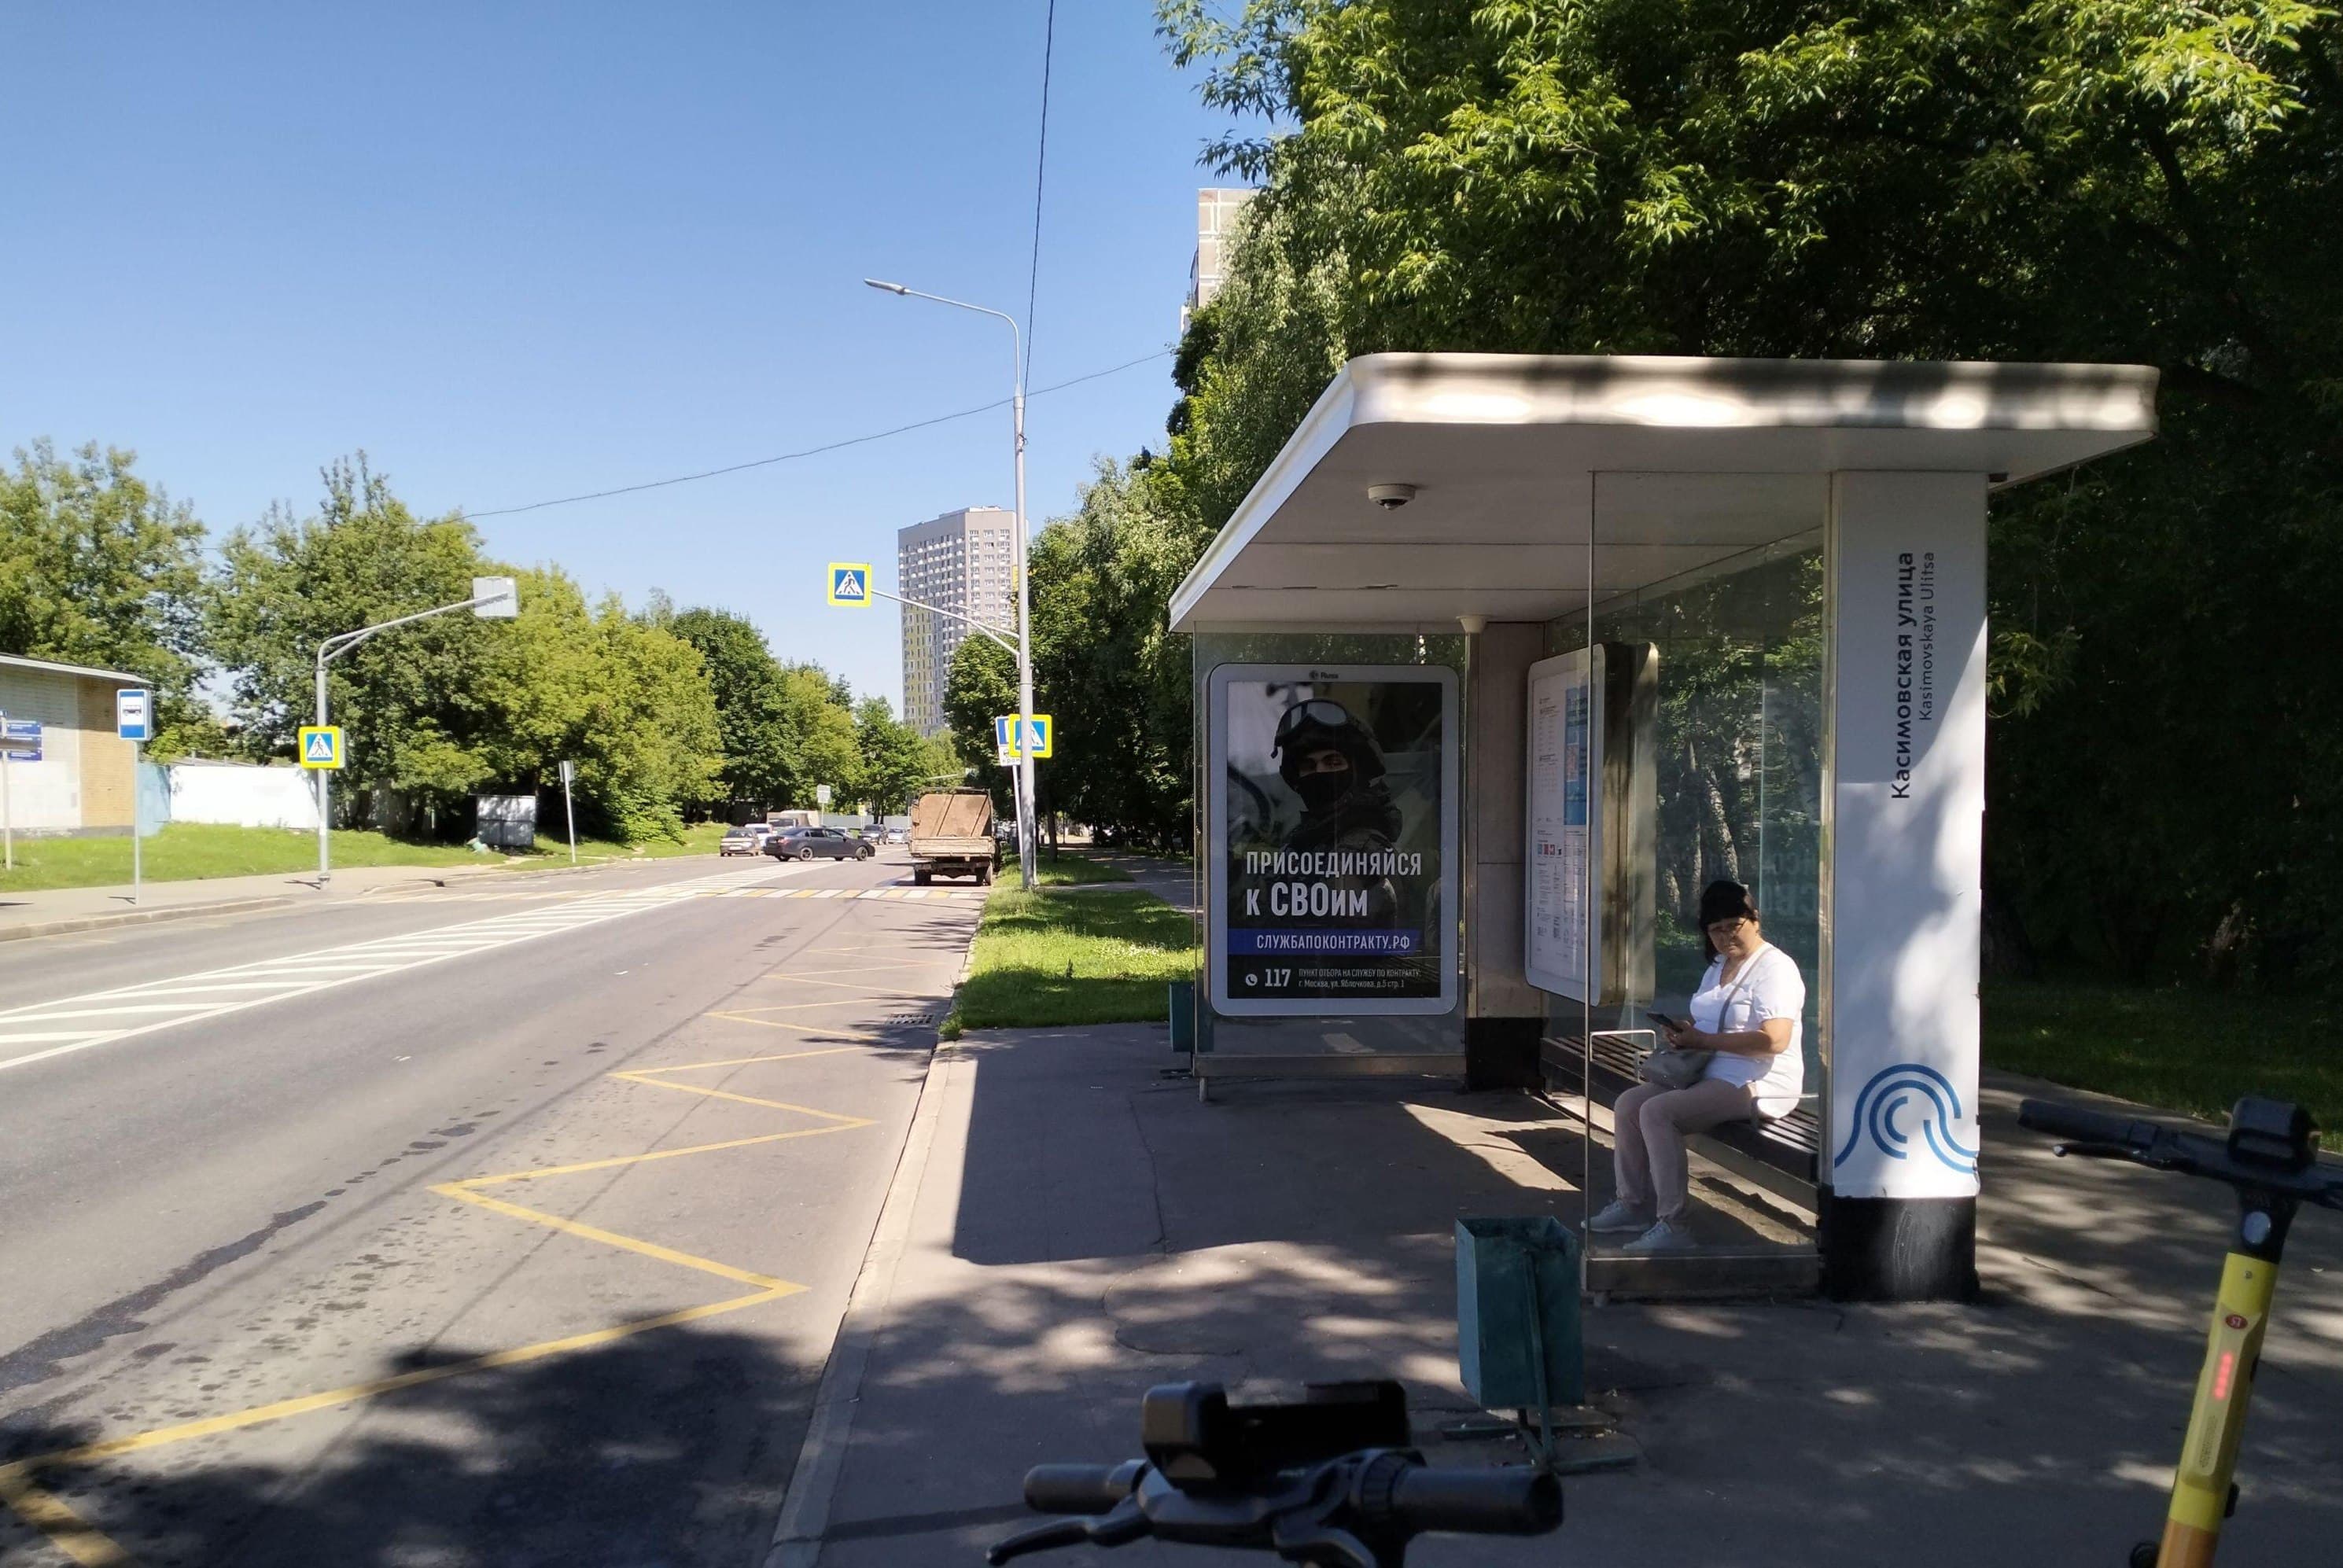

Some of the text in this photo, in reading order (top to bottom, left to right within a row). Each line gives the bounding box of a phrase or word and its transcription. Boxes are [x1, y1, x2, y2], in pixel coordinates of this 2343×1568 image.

[1919, 552, 1936, 721] Kasimovskaya Ulitsa
[1891, 552, 1917, 799] Касимовская улица
[1247, 848, 1422, 878] ПРИСОЕДИНЯЙСЯ
[1257, 934, 1410, 950] СЛУЖБАПОКОНТРАКТУ.РФ
[1265, 969, 1291, 988] 117
[1299, 968, 1318, 977] ПУНКТ
[1319, 968, 1342, 977] ОТБОРА
[1343, 969, 1351, 977] НА
[1352, 969, 1376, 977] СЛУЖБУ
[1377, 969, 1386, 977] ПО
[1400, 979, 1404, 988] 1
